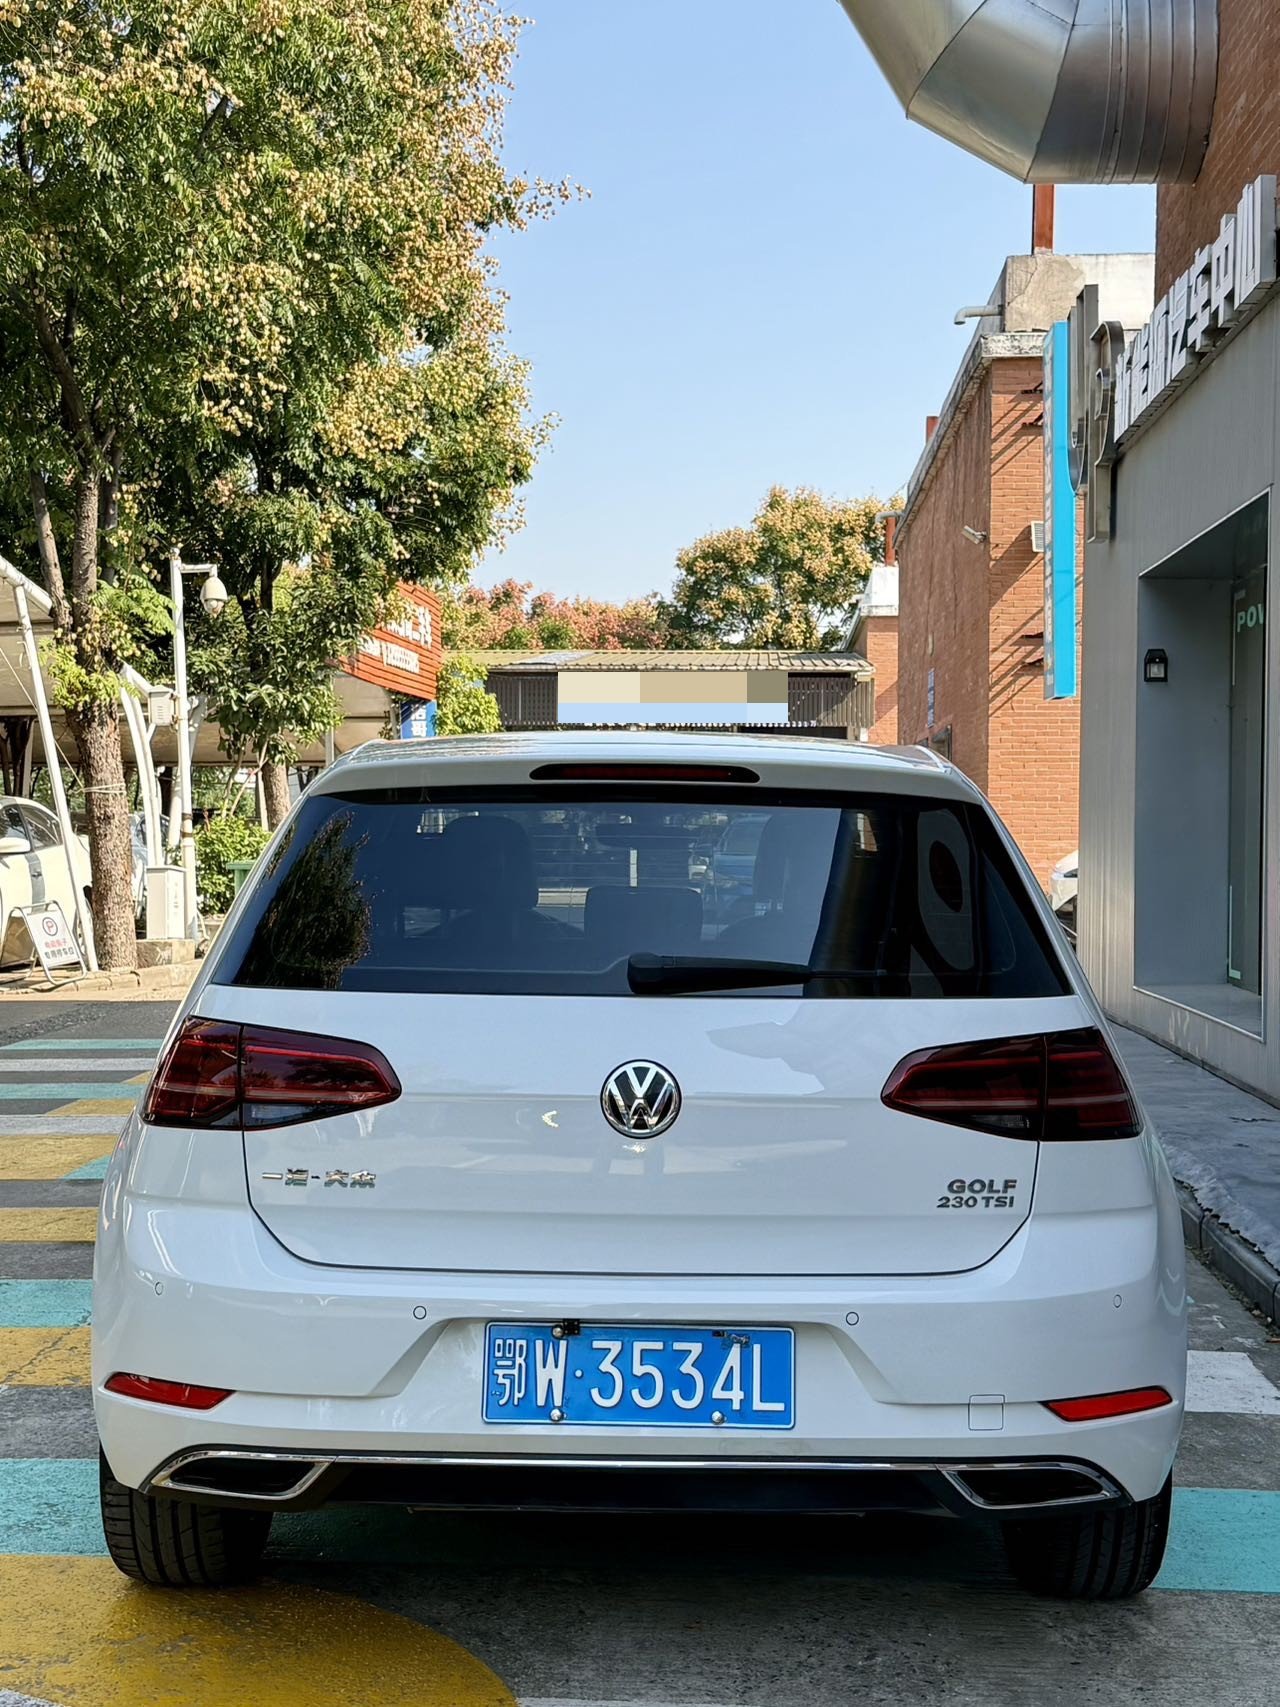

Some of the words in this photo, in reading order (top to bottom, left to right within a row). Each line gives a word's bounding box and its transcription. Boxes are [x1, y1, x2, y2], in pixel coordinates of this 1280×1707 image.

[1114, 174, 1277, 443] 新能源汽车中心
[947, 1179, 1017, 1194] GOLF
[936, 1195, 978, 1208] 230
[981, 1196, 1014, 1208] TSI
